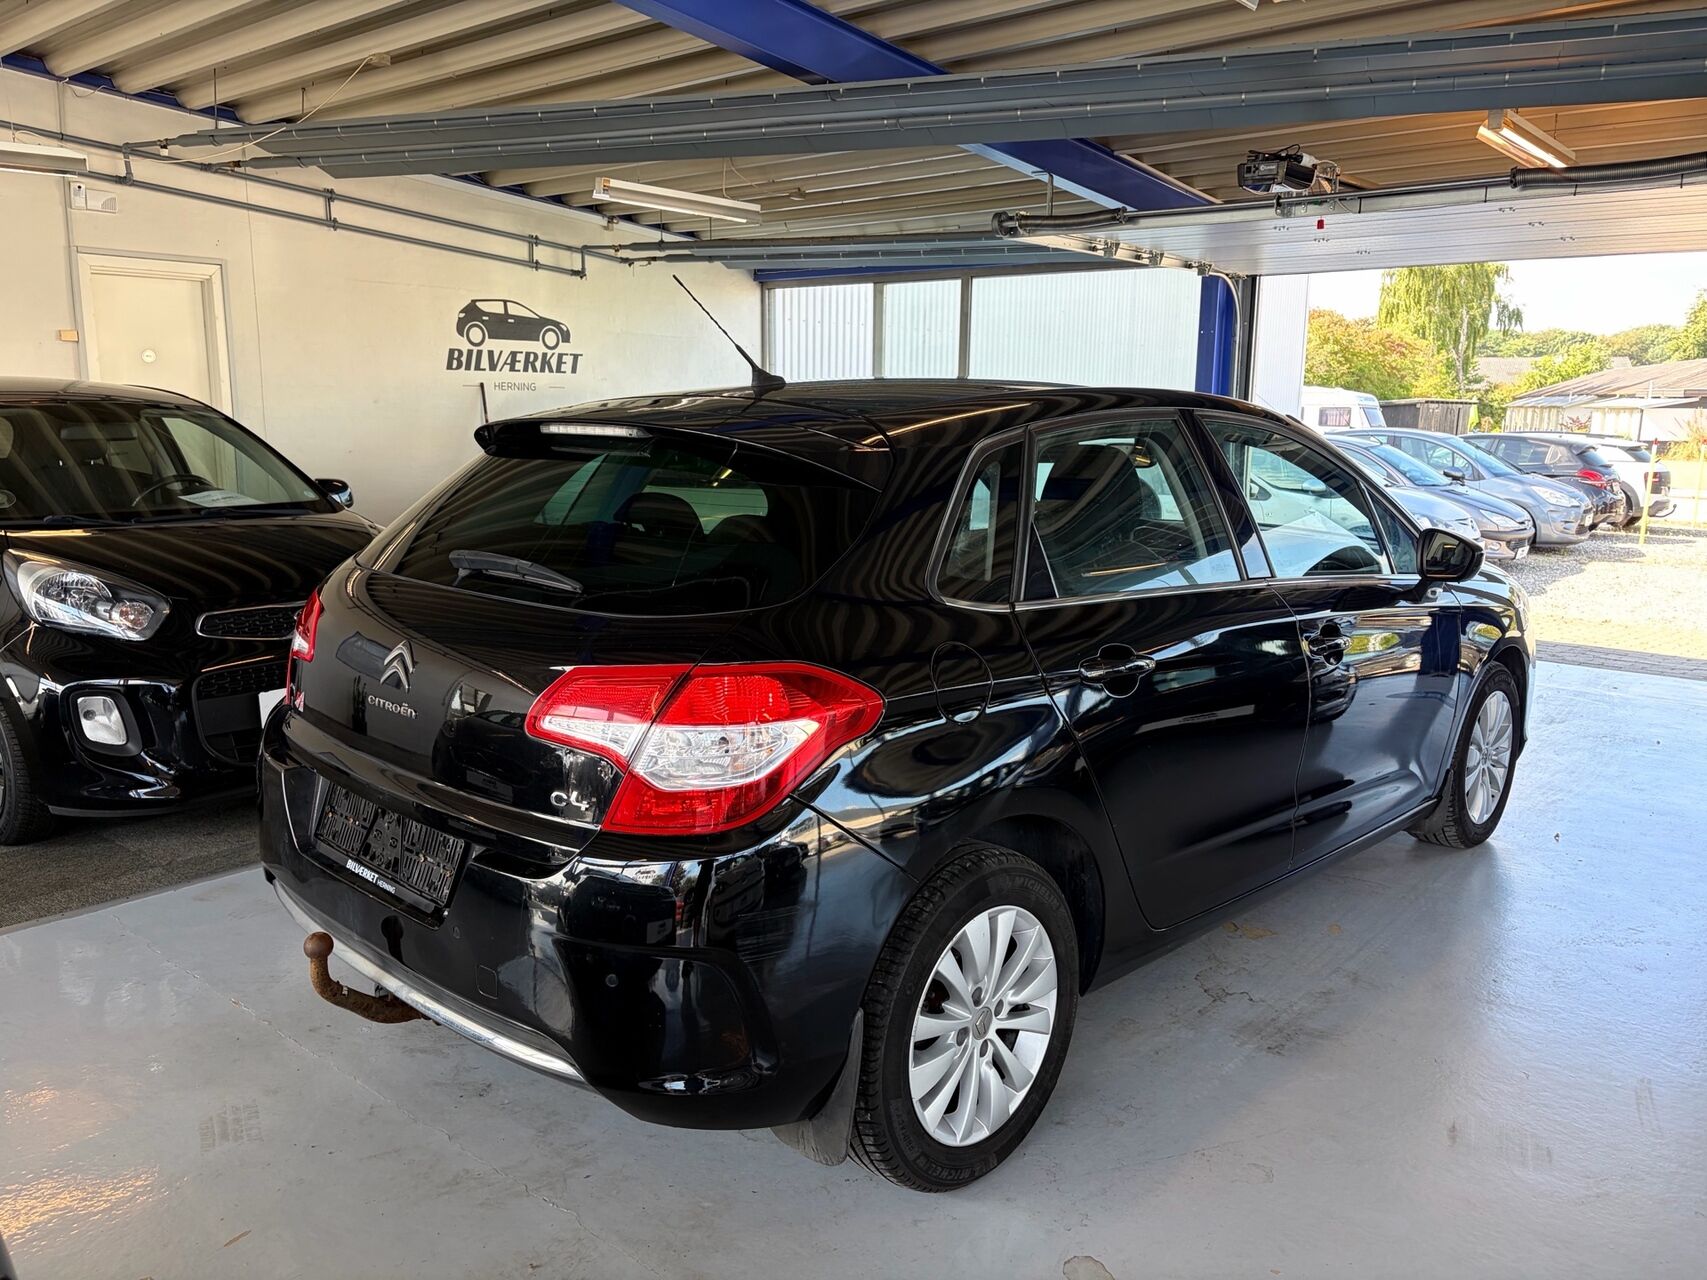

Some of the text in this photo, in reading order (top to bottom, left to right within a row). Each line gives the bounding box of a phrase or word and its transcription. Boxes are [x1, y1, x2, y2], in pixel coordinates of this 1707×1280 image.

[446, 348, 583, 374] BILVÆRKET
[494, 382, 537, 392] HERNING
[550, 791, 589, 811] C4
[346, 859, 396, 894] BILVÆRKET HERNING
[915, 1155, 972, 1180] MICHELIN
